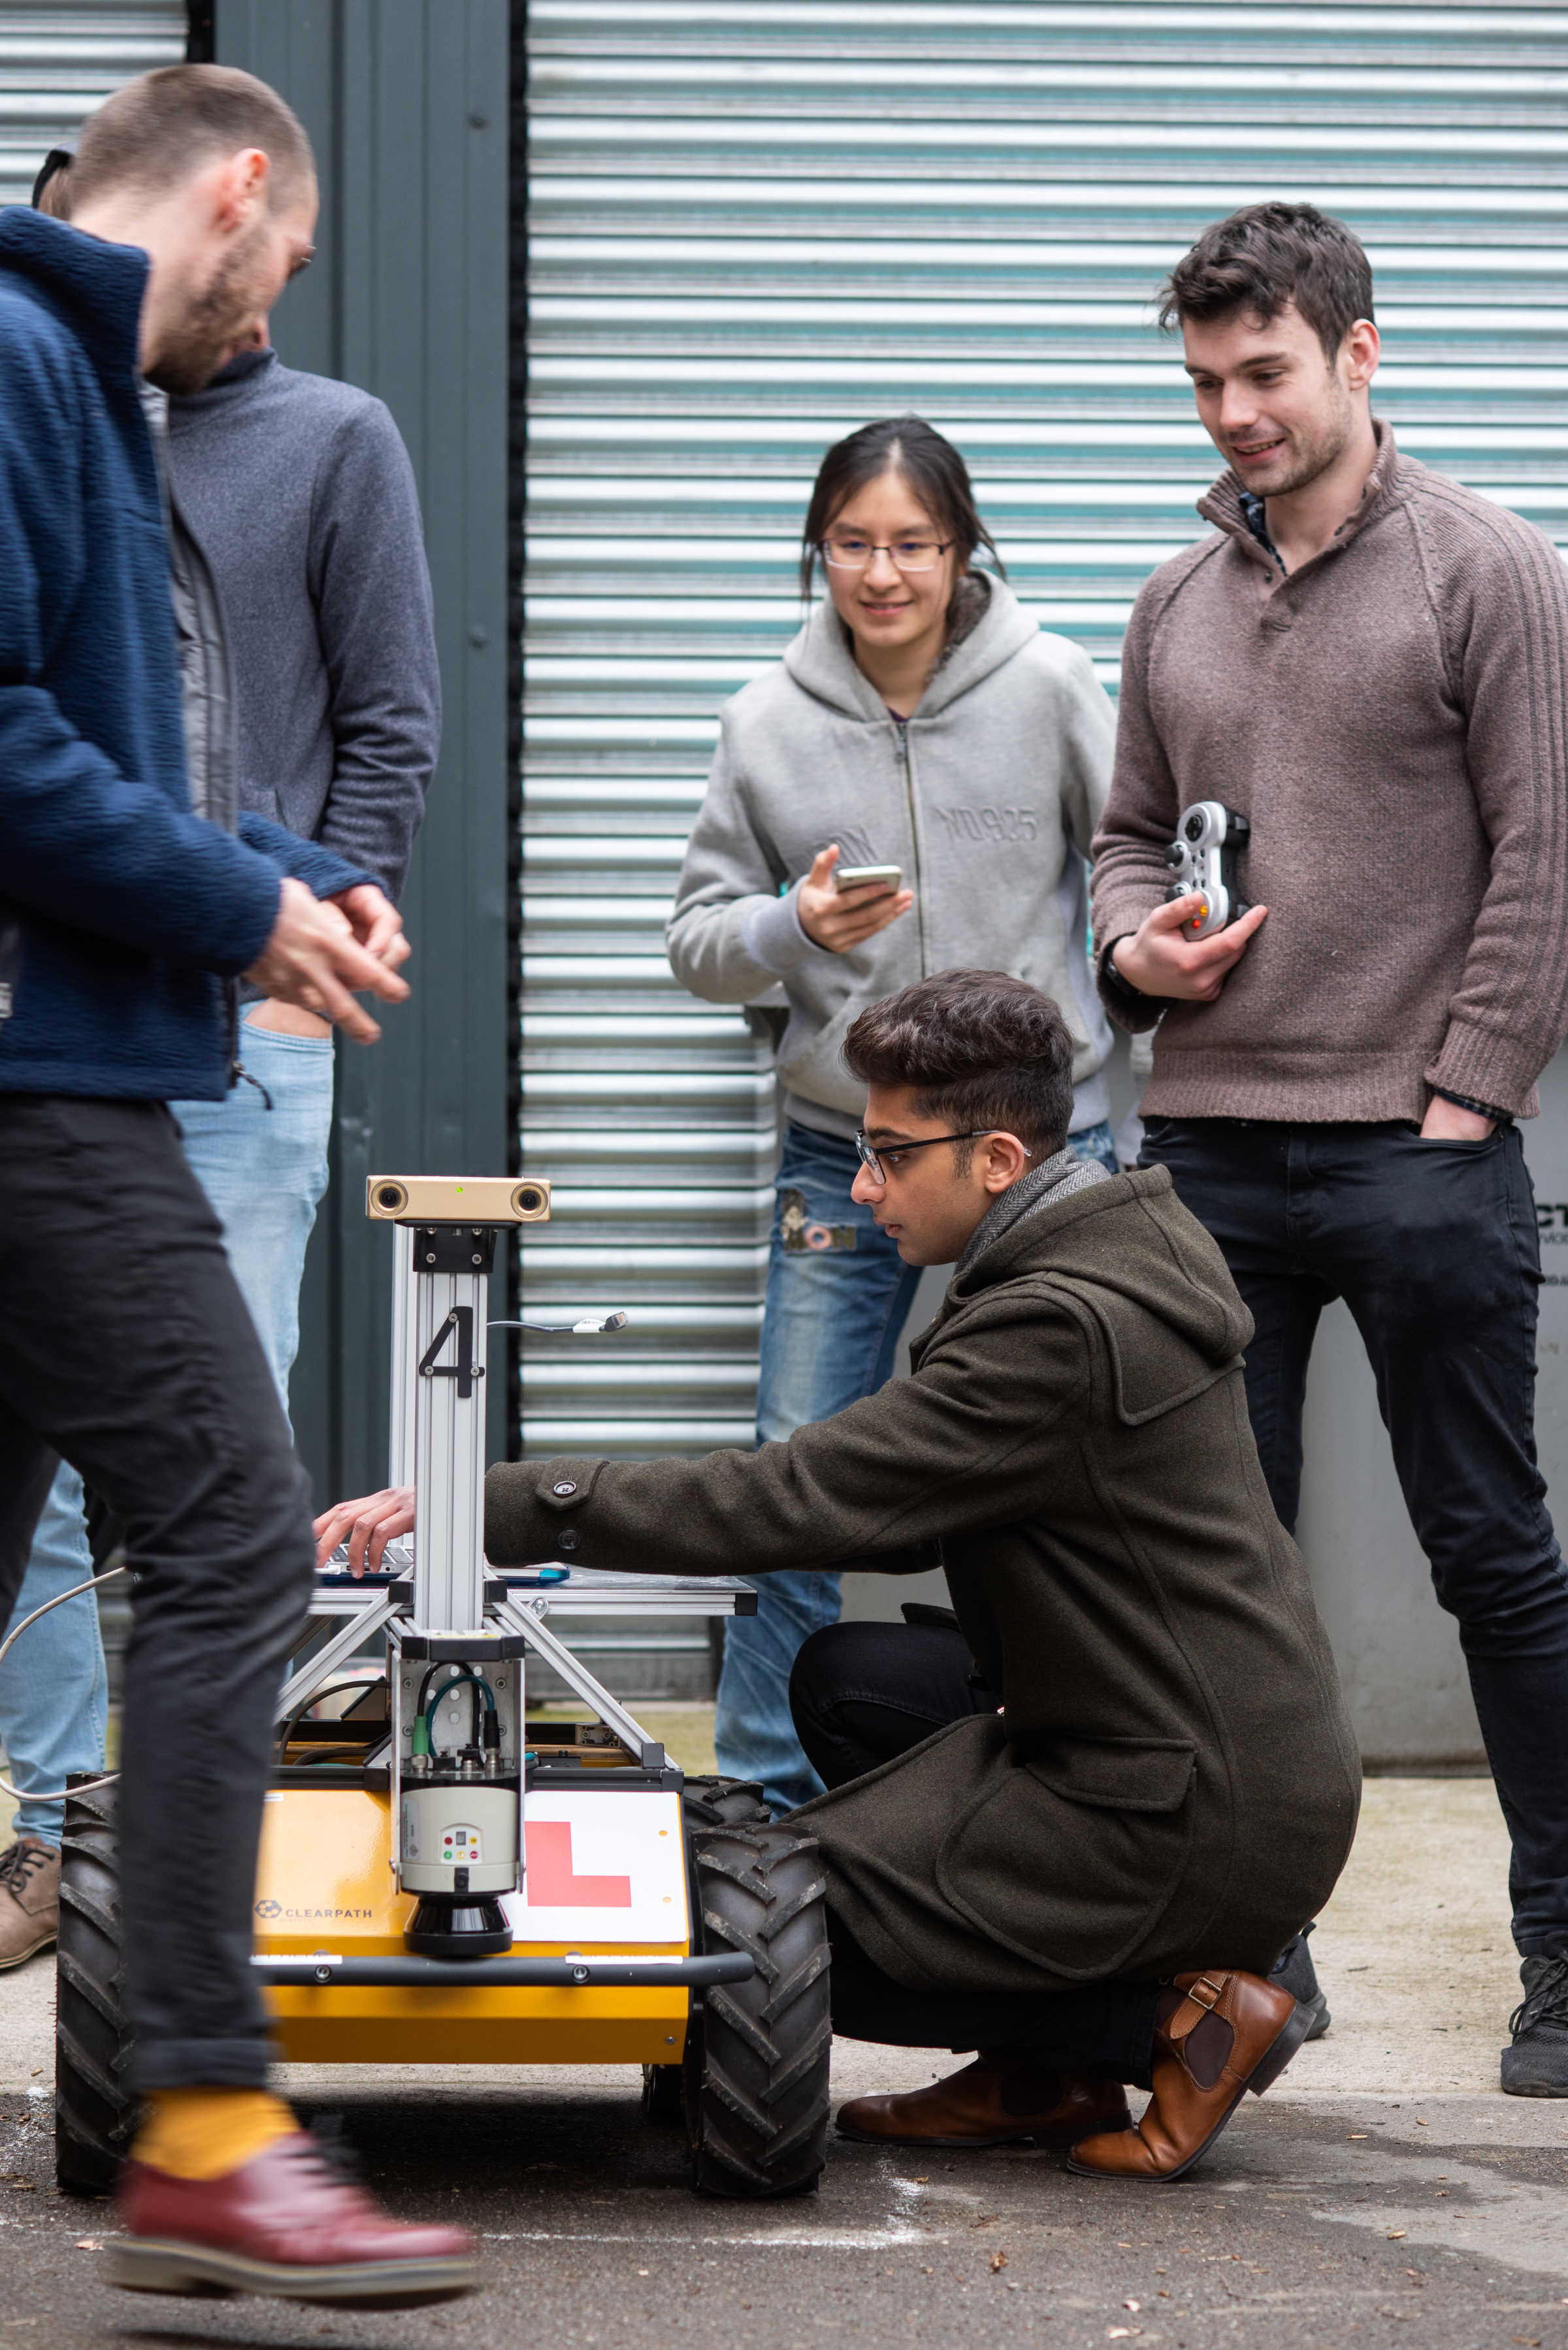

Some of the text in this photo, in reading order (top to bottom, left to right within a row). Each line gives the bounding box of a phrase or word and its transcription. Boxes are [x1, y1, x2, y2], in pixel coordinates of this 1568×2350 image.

[419, 1306, 485, 1398] 4
[524, 1821, 632, 1908] L
[286, 1909, 372, 1918] CLEARPATH
